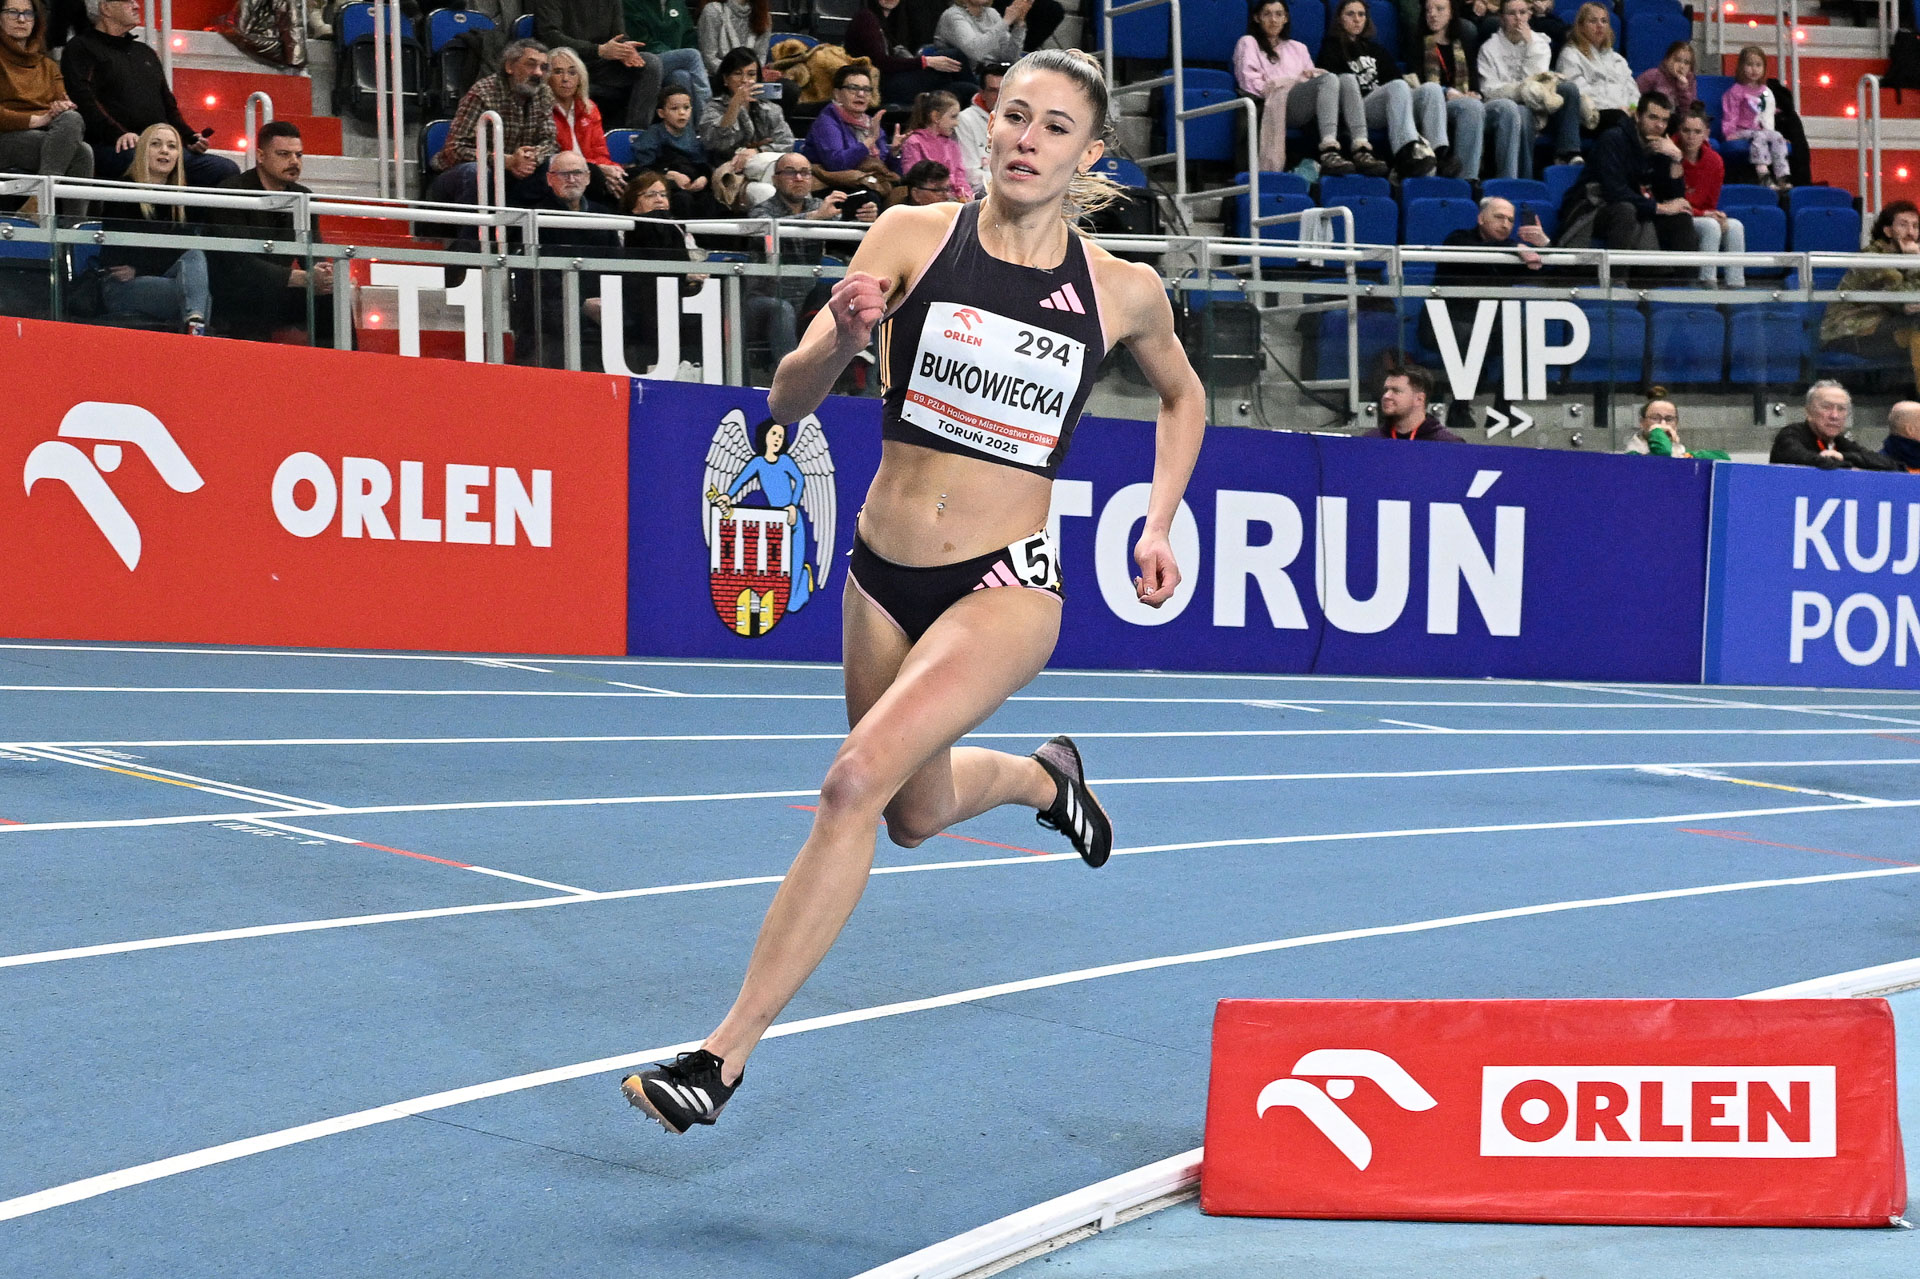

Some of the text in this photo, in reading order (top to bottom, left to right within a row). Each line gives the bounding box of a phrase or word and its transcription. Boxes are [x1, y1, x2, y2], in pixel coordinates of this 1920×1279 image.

[370, 263, 484, 363] T1
[600, 274, 723, 385] U1
[943, 329, 983, 347] ORLEN
[1014, 330, 1070, 367] 294
[1425, 299, 1591, 400] VIP
[919, 351, 1064, 418] BUKOWIECKA
[913, 393, 1054, 445] 69. PZLA Halowe Mistrzostwa Polski
[938, 419, 1019, 454] TORUŃ 2025
[271, 451, 553, 548] ORLEN
[1025, 537, 1049, 586] 5
[1501, 1078, 1811, 1143] ORLEN
